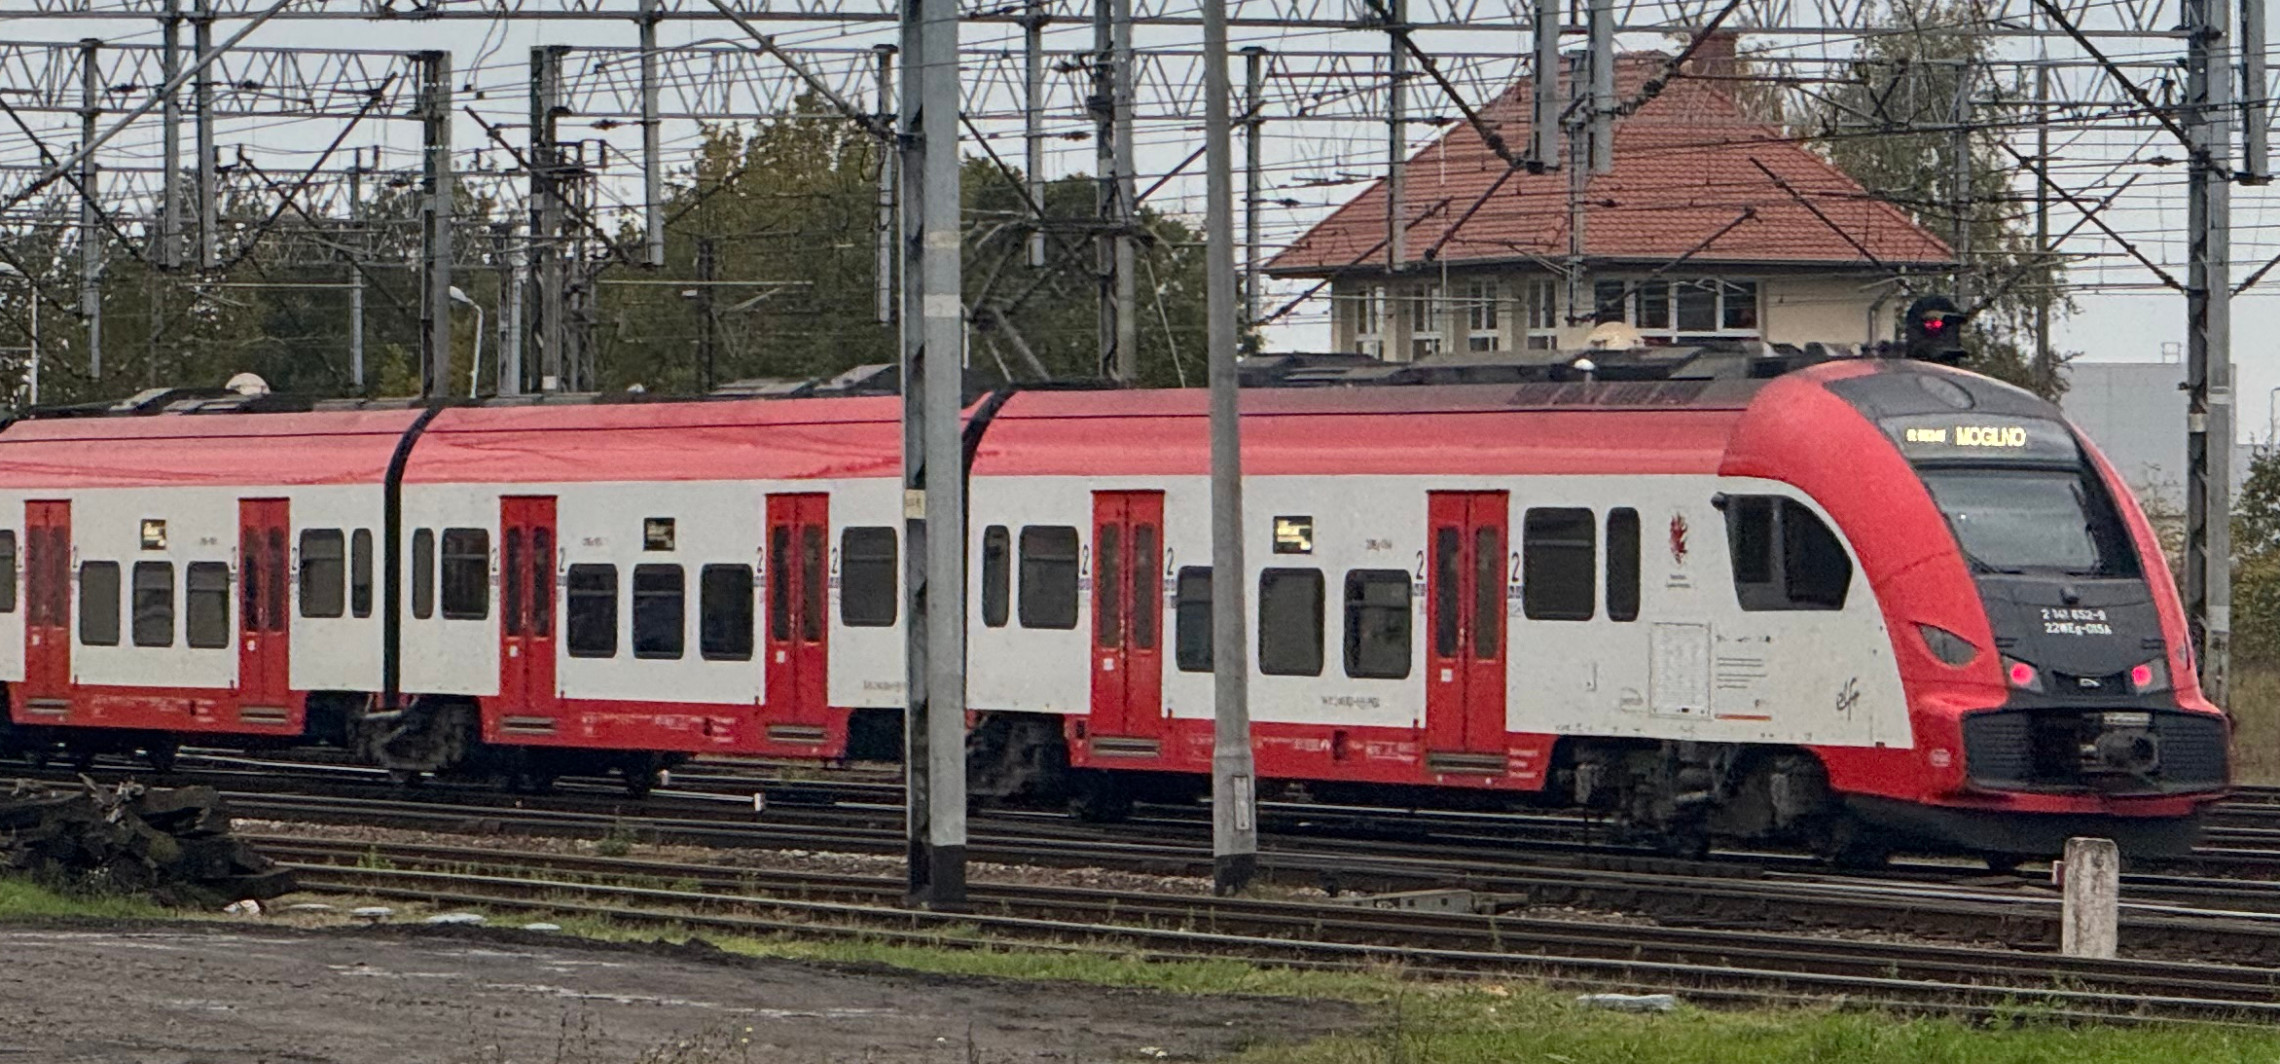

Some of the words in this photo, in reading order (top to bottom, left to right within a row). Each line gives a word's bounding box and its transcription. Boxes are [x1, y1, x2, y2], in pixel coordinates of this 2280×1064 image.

[1956, 426, 2026, 446] MOGILNO
[831, 546, 839, 574] 2
[1081, 544, 1089, 575] 2
[1167, 547, 1174, 576] 2
[1416, 550, 1424, 580] 2
[1511, 552, 1520, 582] 2
[2040, 609, 2050, 620] 2
